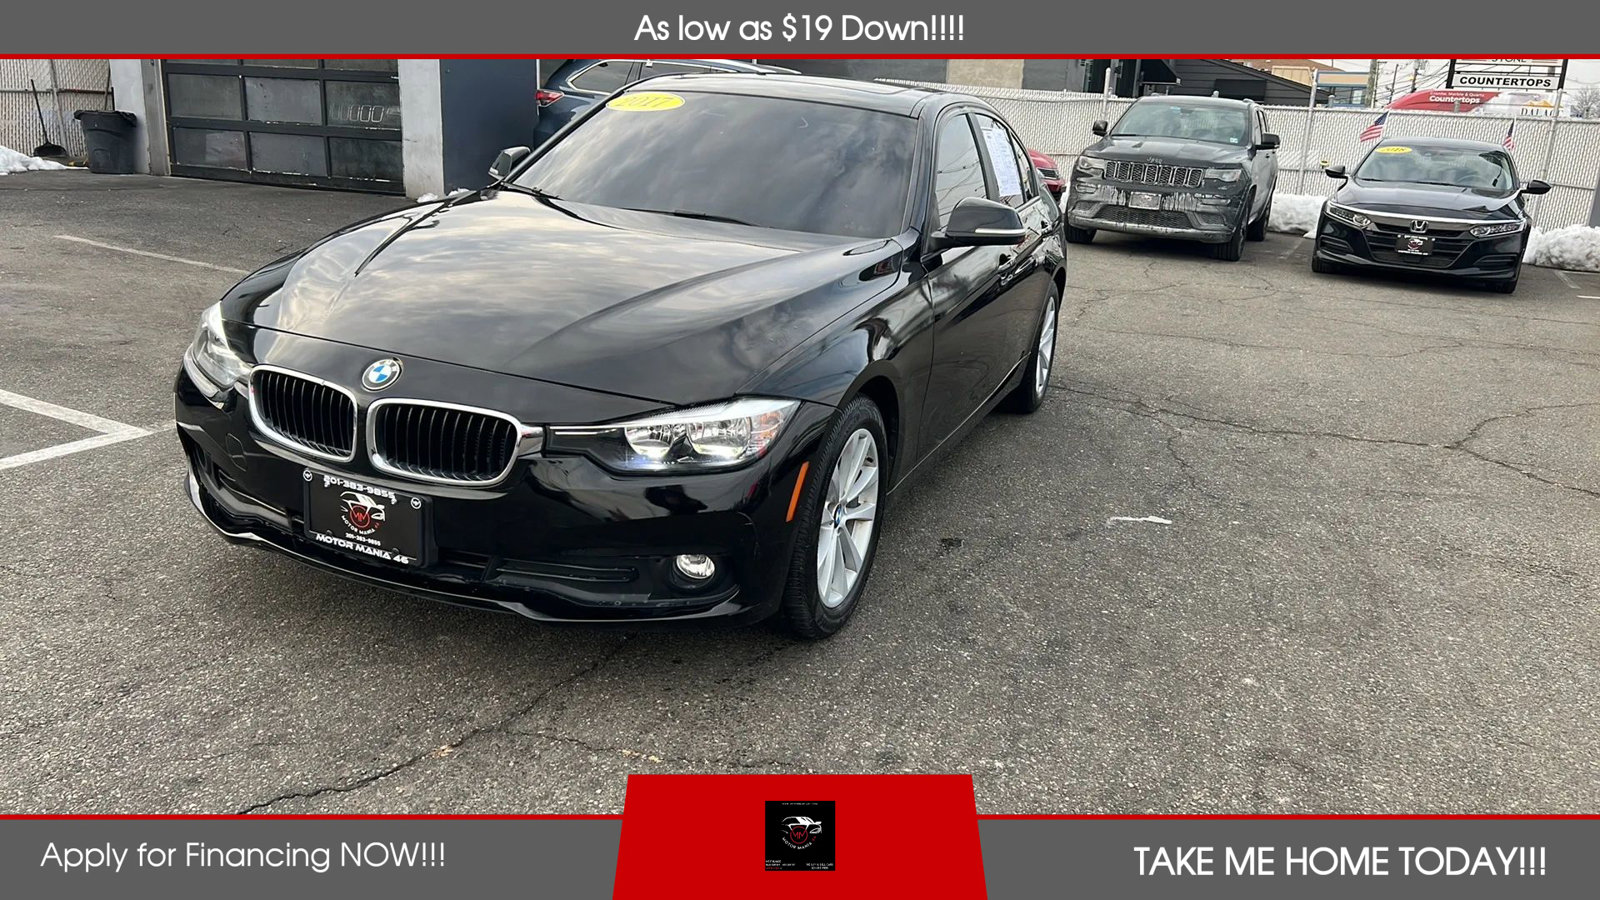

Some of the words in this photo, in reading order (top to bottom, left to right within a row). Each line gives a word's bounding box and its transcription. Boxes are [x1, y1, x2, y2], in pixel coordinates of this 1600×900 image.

[1460, 76, 1551, 87] COUNTERTOPS
[315, 533, 354, 550] MOTOR
[355, 544, 391, 560] MANIA
[393, 555, 409, 565] 46
